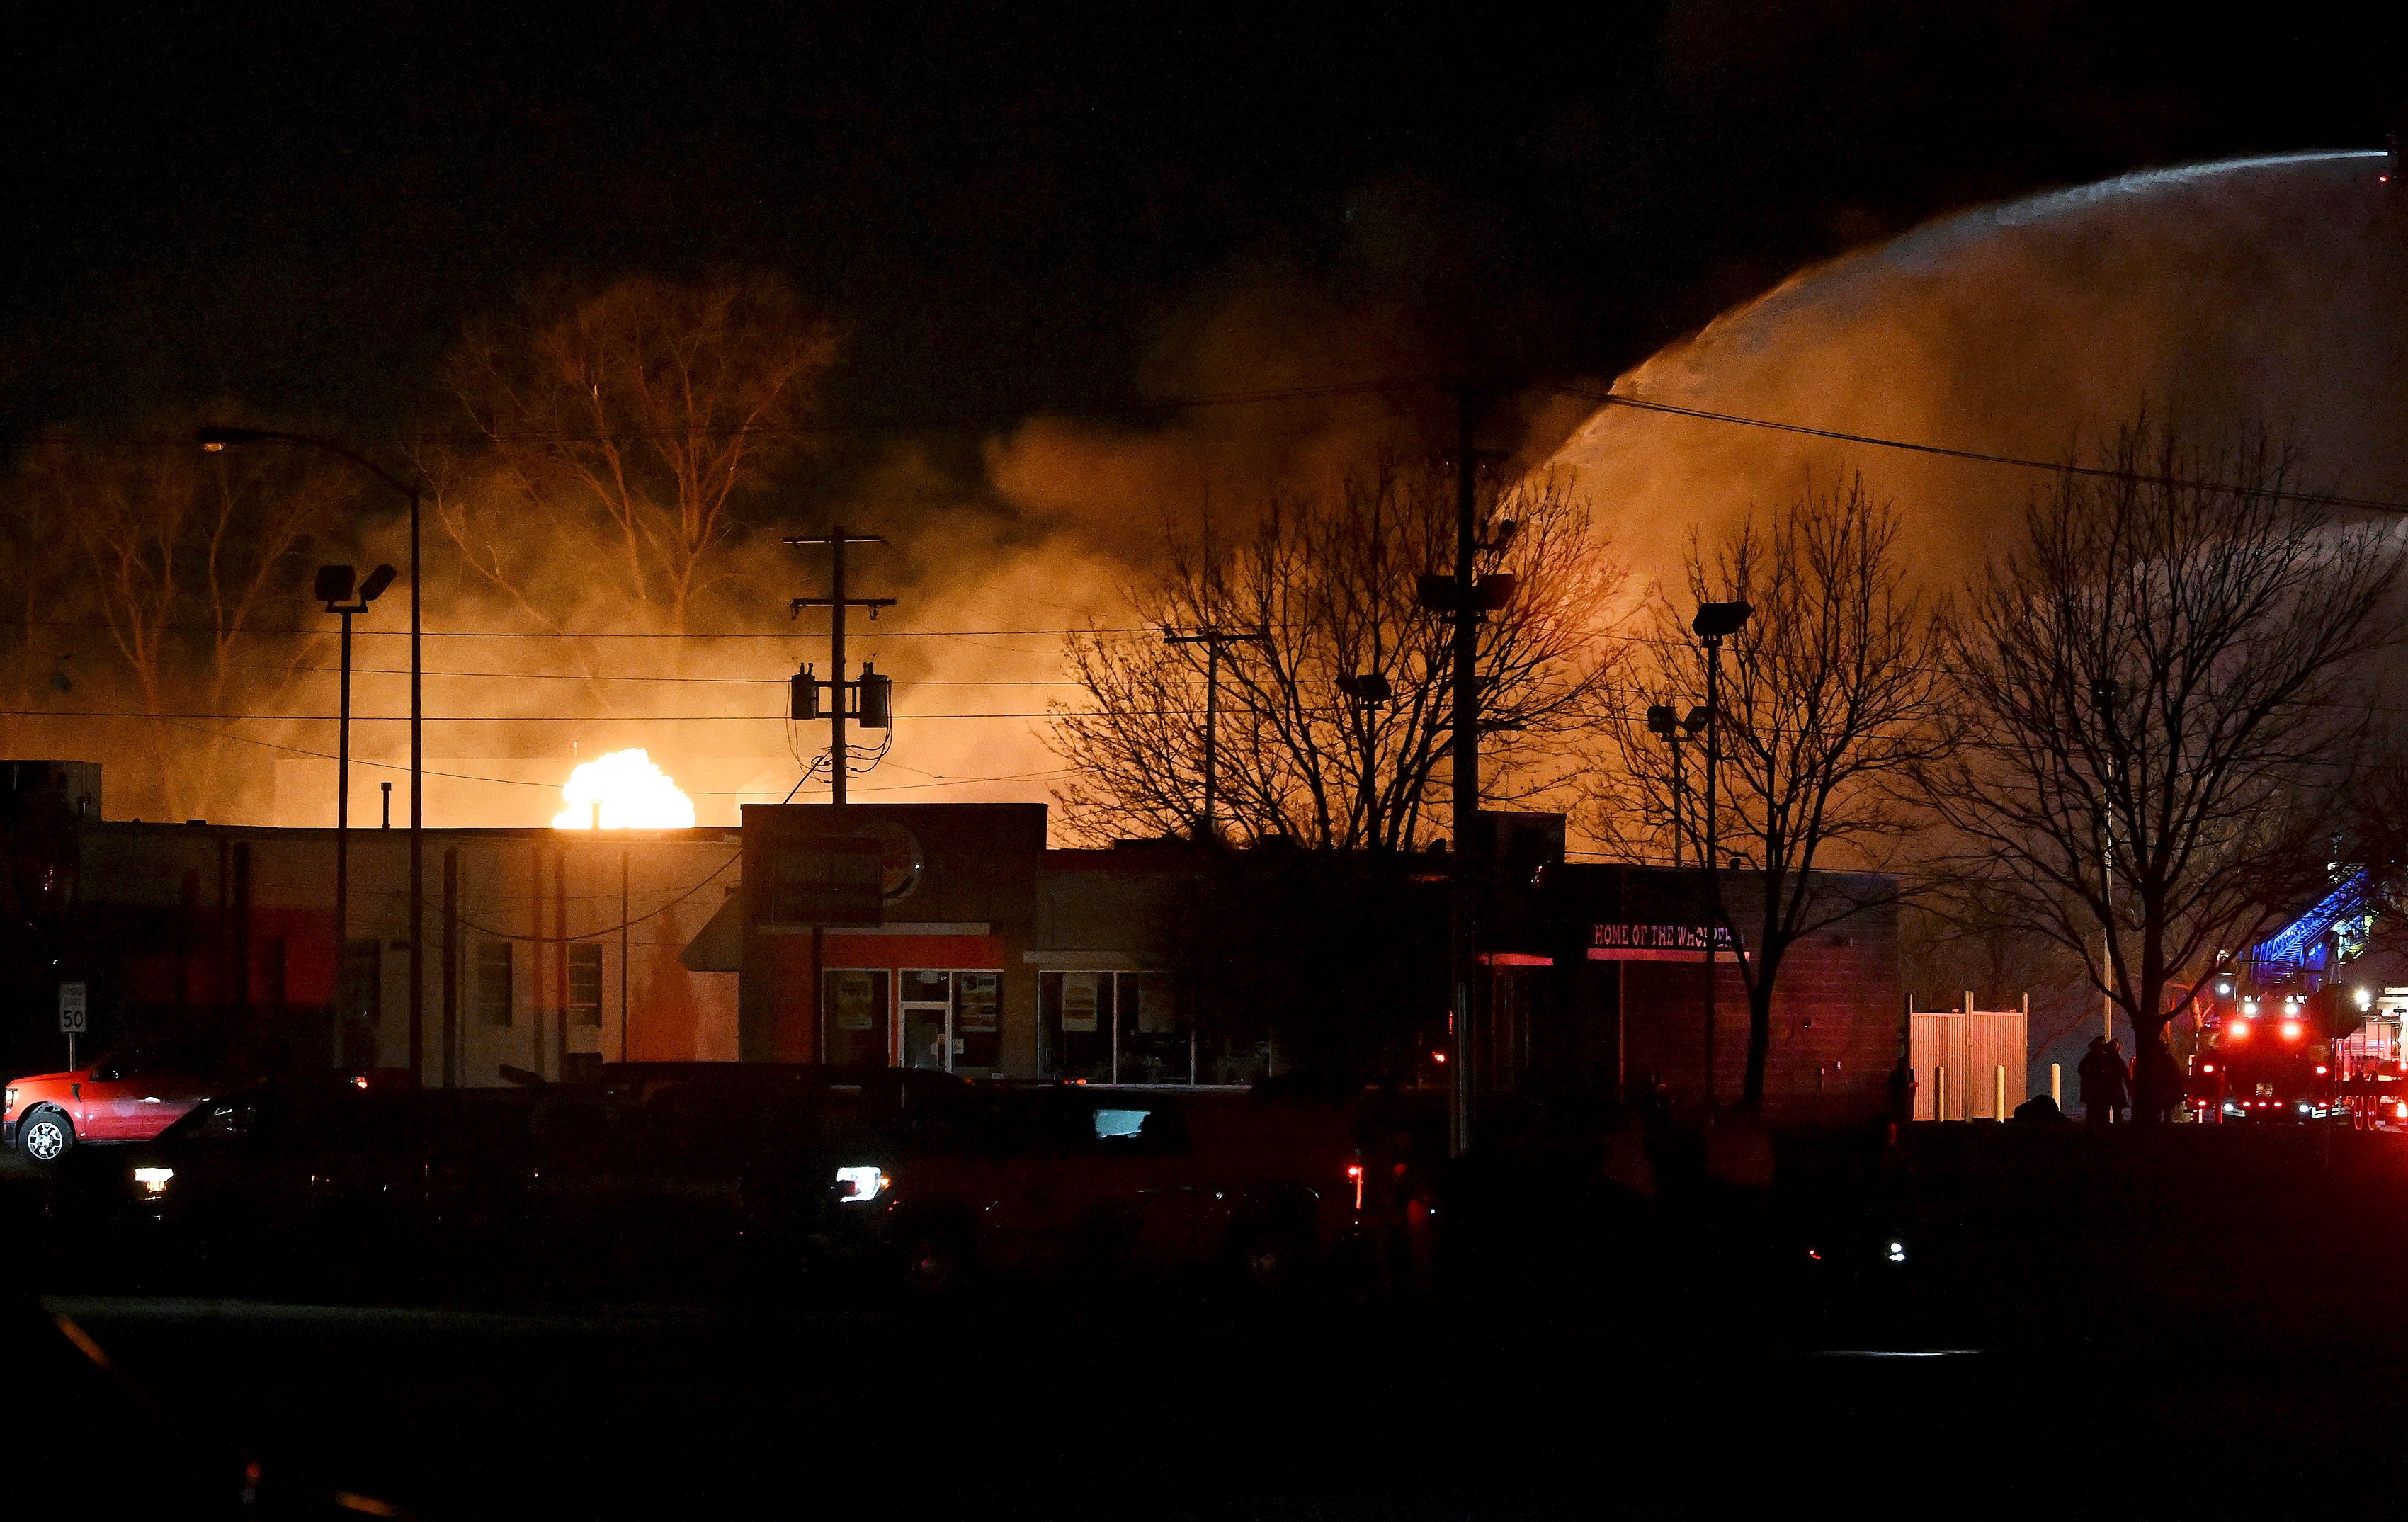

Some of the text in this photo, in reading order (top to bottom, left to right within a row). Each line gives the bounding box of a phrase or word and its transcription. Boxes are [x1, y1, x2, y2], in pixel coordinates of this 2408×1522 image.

[1594, 924, 1629, 945] HOME
[1632, 924, 1647, 945] OF
[1651, 925, 1674, 946] THE
[63, 1009, 84, 1028] 50
